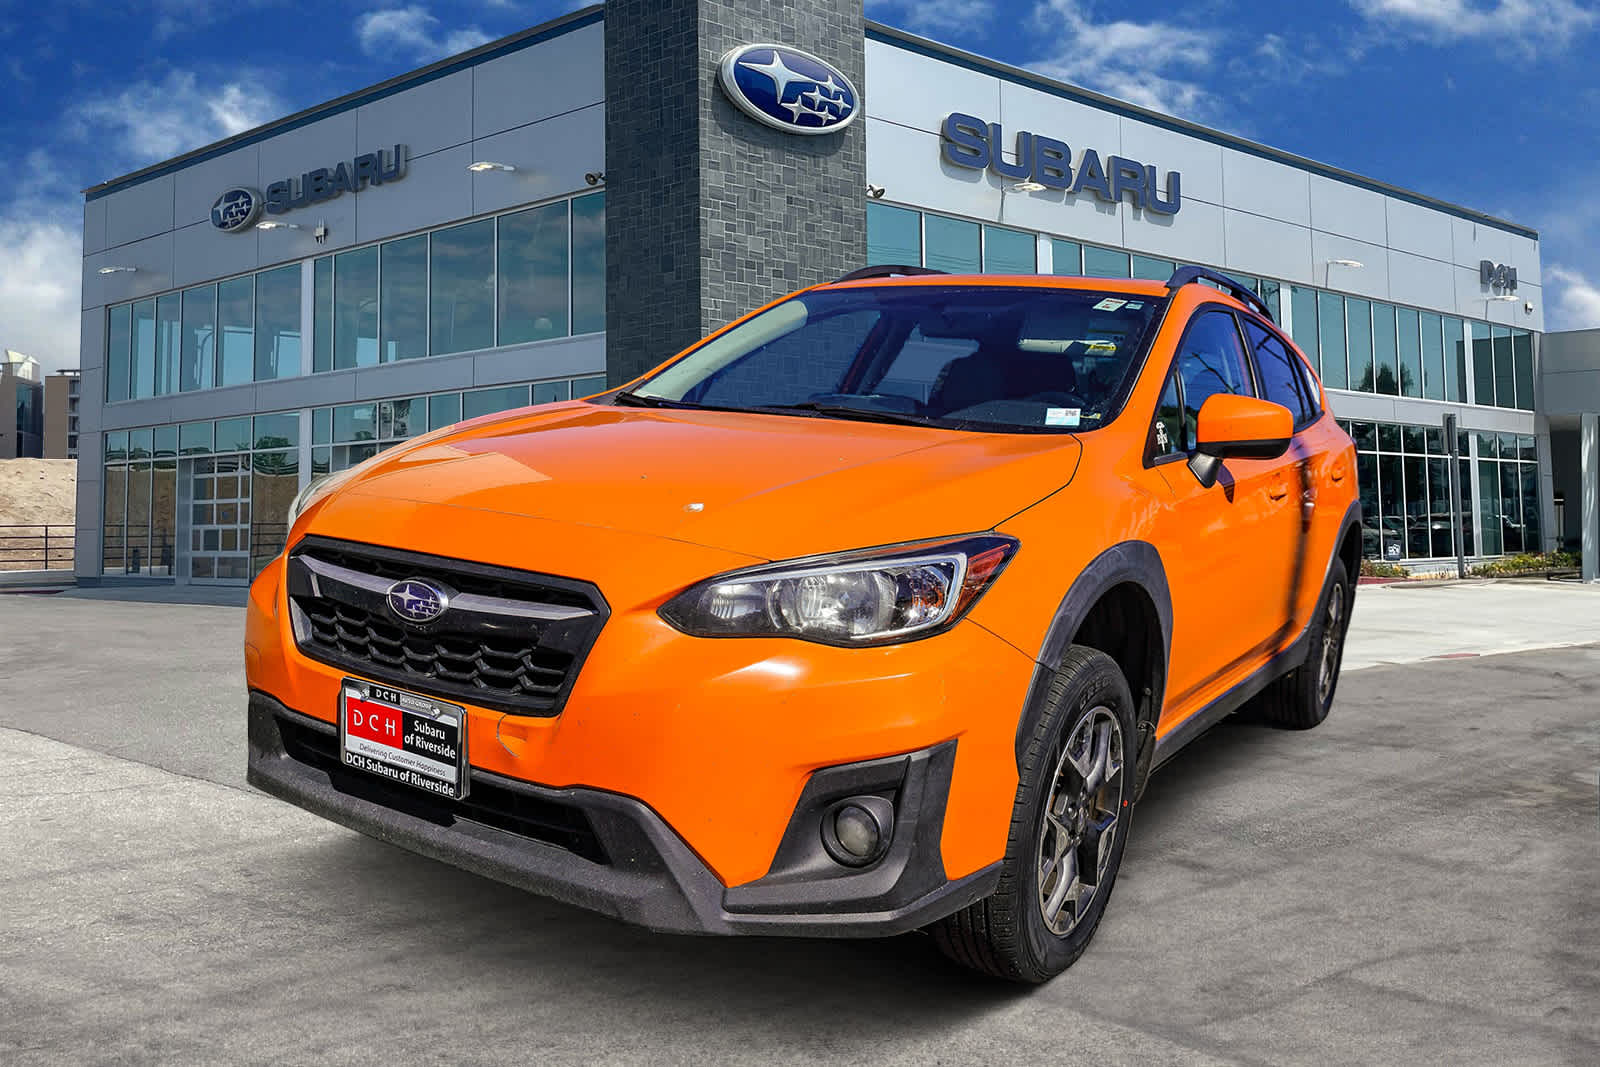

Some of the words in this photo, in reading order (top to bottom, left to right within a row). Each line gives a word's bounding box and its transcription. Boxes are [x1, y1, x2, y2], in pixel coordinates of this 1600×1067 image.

[266, 144, 408, 214] SUBARU
[941, 112, 1181, 215] SUBARU
[375, 688, 397, 702] DCH
[404, 733, 415, 746] of
[415, 736, 456, 760] Riverside
[414, 719, 446, 740] Subaru
[346, 751, 365, 769] DCH
[366, 758, 399, 779] Subaru
[399, 769, 411, 782] of
[411, 772, 455, 797] Riverside
[359, 742, 388, 761] Delivering
[388, 751, 416, 767] Customer
[415, 760, 447, 777] Happiness
